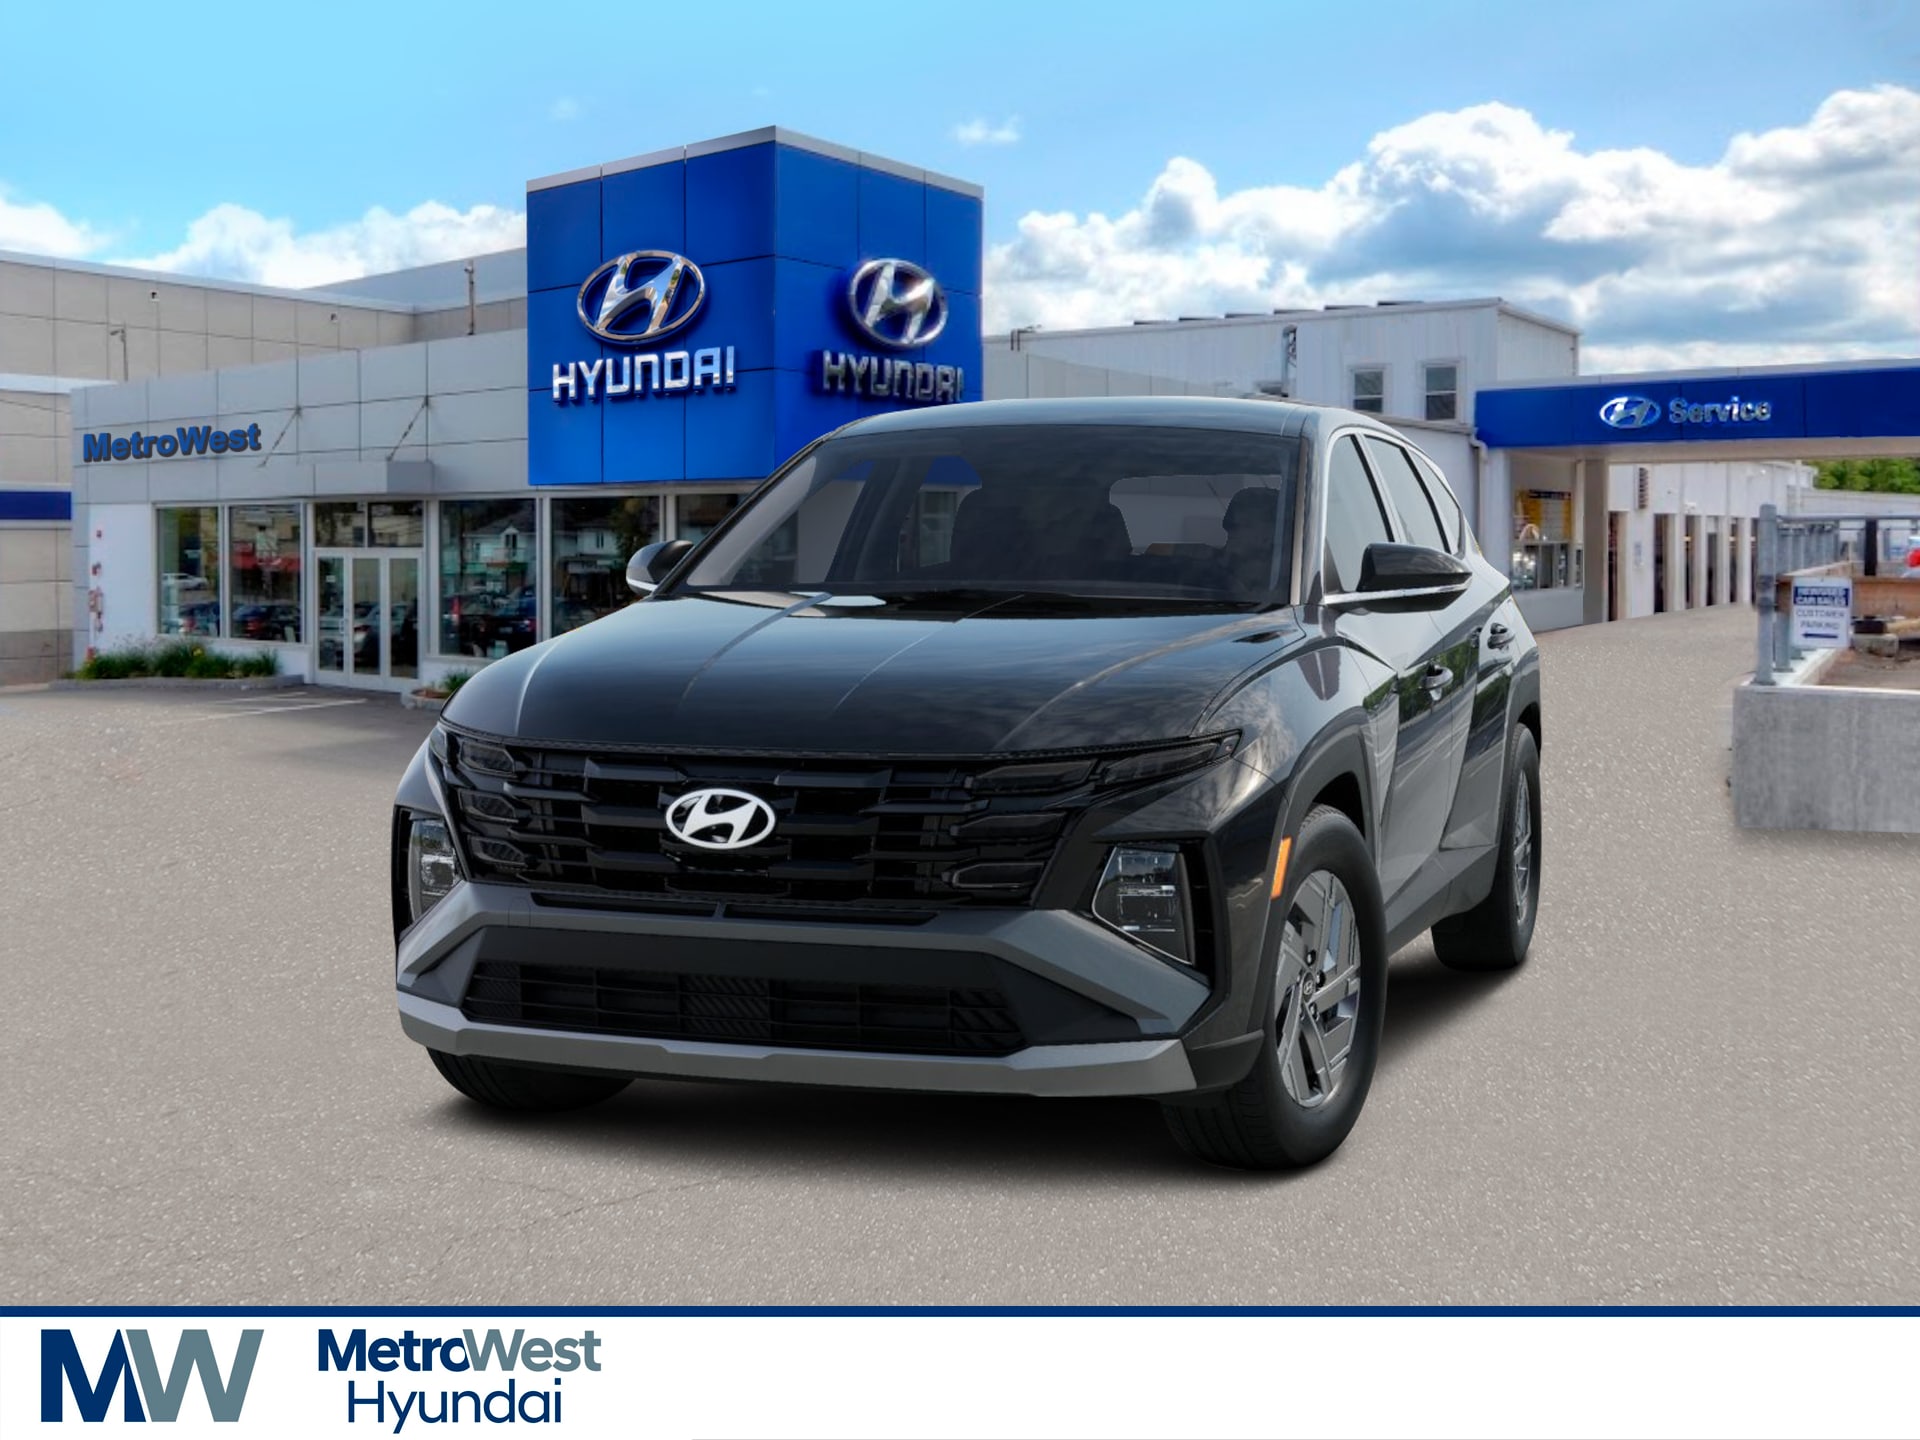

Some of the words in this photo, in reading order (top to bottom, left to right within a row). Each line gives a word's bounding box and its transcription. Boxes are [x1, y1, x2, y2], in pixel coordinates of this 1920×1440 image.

[552, 346, 736, 401] HYUNDAI
[822, 350, 964, 403] HYUNDAI
[1669, 396, 1772, 424] Service
[83, 423, 261, 462] MetroWest
